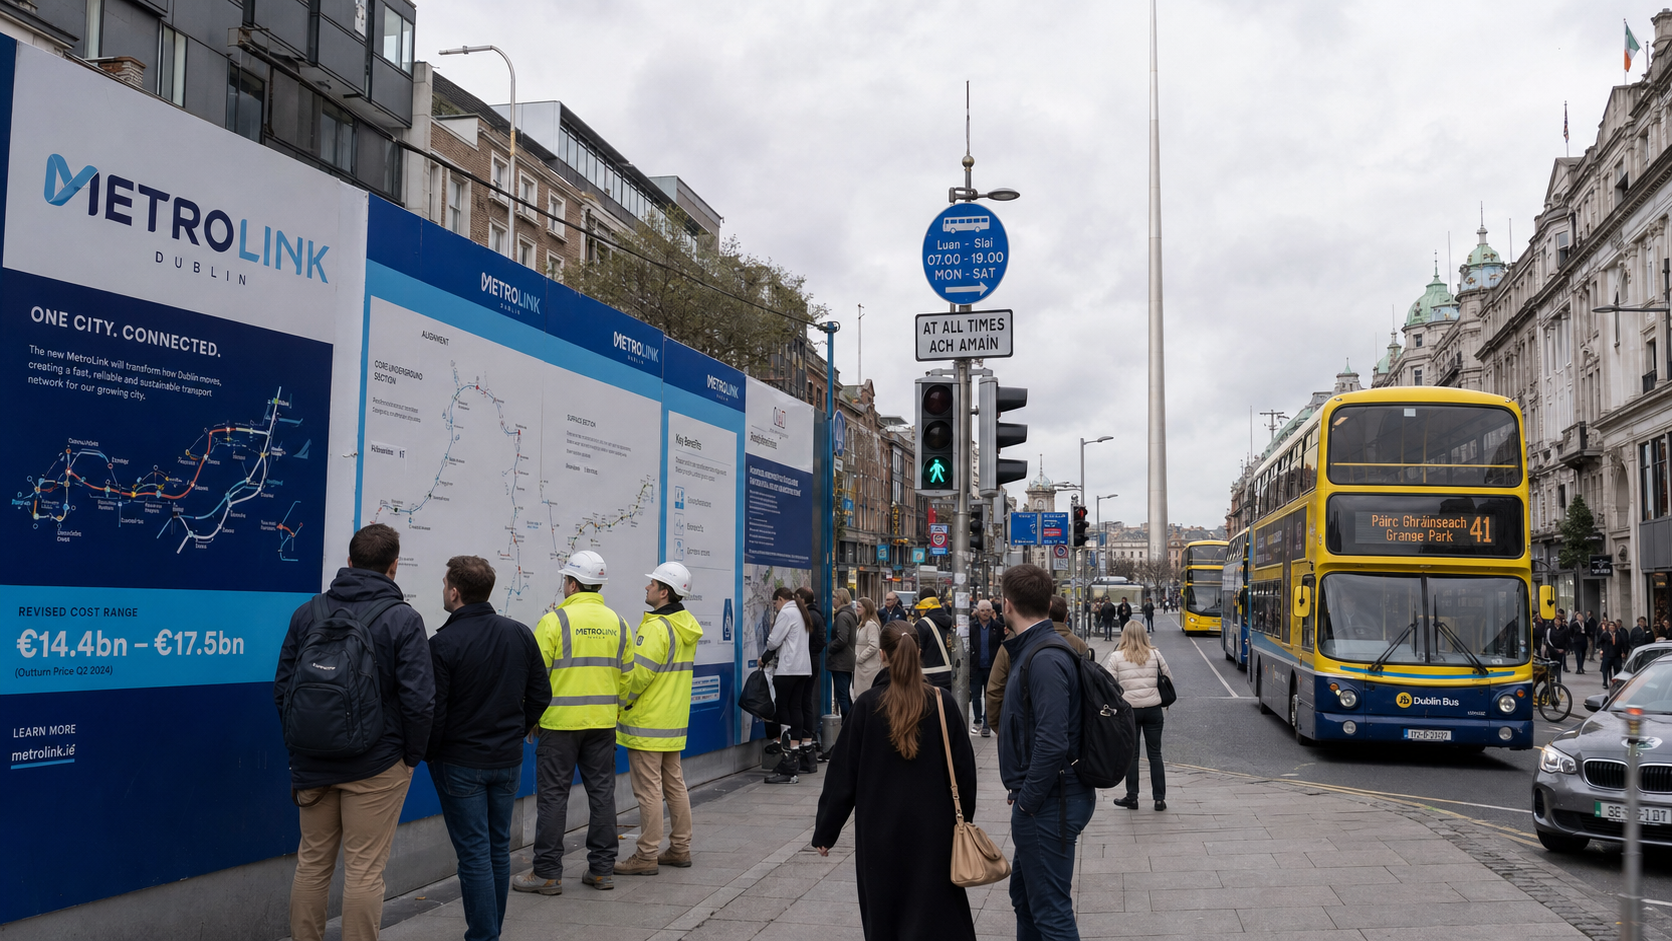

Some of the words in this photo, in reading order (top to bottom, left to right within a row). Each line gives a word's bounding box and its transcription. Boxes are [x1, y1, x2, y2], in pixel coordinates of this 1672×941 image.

[44, 153, 330, 284] METROLINK
[937, 240, 960, 250] Luan
[928, 254, 960, 265] 07.00
[971, 252, 1004, 264] 19.00
[156, 252, 246, 286] DUBLIN
[935, 269, 962, 280] MON
[973, 268, 996, 279] SAT
[481, 272, 540, 314] METROLINK
[31, 306, 68, 328] ONE
[74, 315, 117, 337] CITY.
[123, 325, 221, 358] CONNECTED.
[923, 322, 938, 335] AT
[942, 320, 963, 334] ALL
[968, 318, 1004, 332] TIMES
[929, 339, 954, 353] ACH
[29, 344, 44, 356] The
[47, 350, 64, 359] new
[67, 352, 109, 367] MetroLink
[126, 362, 161, 376] transform
[162, 367, 176, 378] how
[28, 361, 63, 375] creating
[72, 366, 91, 379] fast,
[124, 376, 138, 386] and
[140, 378, 180, 392] sustainable
[182, 385, 212, 398] transport
[28, 374, 63, 388] network
[66, 379, 78, 390] for
[81, 383, 95, 392] our
[97, 386, 128, 399] growing
[130, 389, 146, 401] city.
[1372, 514, 1399, 527] Páirc
[1386, 529, 1424, 542] Grange
[1429, 530, 1453, 542] Park
[1470, 516, 1492, 543] 41
[18, 606, 66, 617] REVISED
[70, 606, 100, 617] COST
[103, 607, 138, 617] RANGE
[17, 628, 128, 658] €14.4bn
[154, 628, 244, 656] €17.5bn
[15, 667, 51, 678] (Outturn
[53, 666, 74, 676] Price
[76, 666, 88, 676] Q2
[90, 666, 113, 676] 2024)
[1414, 697, 1441, 705] Dublin
[1443, 698, 1459, 706] Bus
[13, 726, 46, 738] LEARN
[49, 724, 76, 736] MORE
